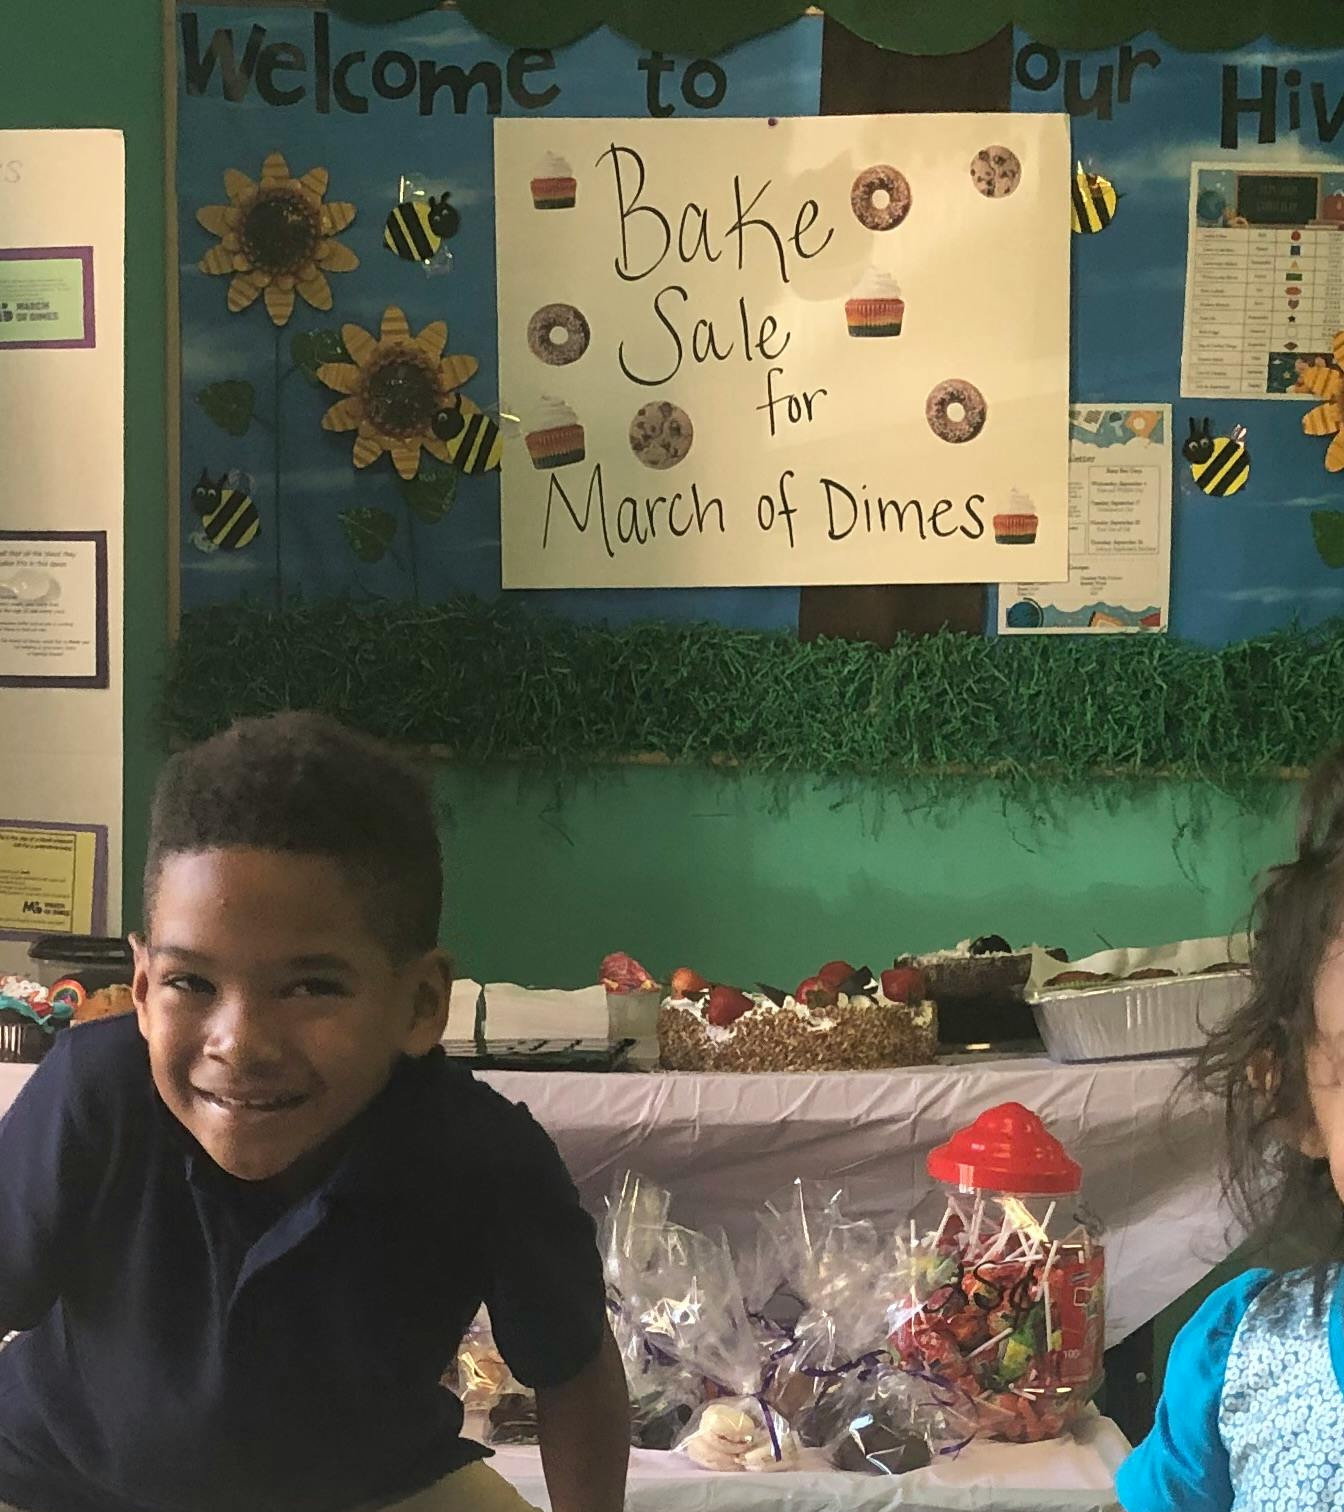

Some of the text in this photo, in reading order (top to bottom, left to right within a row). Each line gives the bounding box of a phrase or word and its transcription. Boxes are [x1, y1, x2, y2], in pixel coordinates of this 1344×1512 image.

[179, 12, 562, 115] Welcome
[637, 51, 727, 117] to
[1015, 40, 1161, 121] our
[595, 143, 835, 283] Bake
[618, 286, 791, 386] Sale
[755, 367, 828, 437] for
[542, 463, 725, 558] March
[757, 470, 797, 549] of
[820, 477, 986, 541] Dimes
